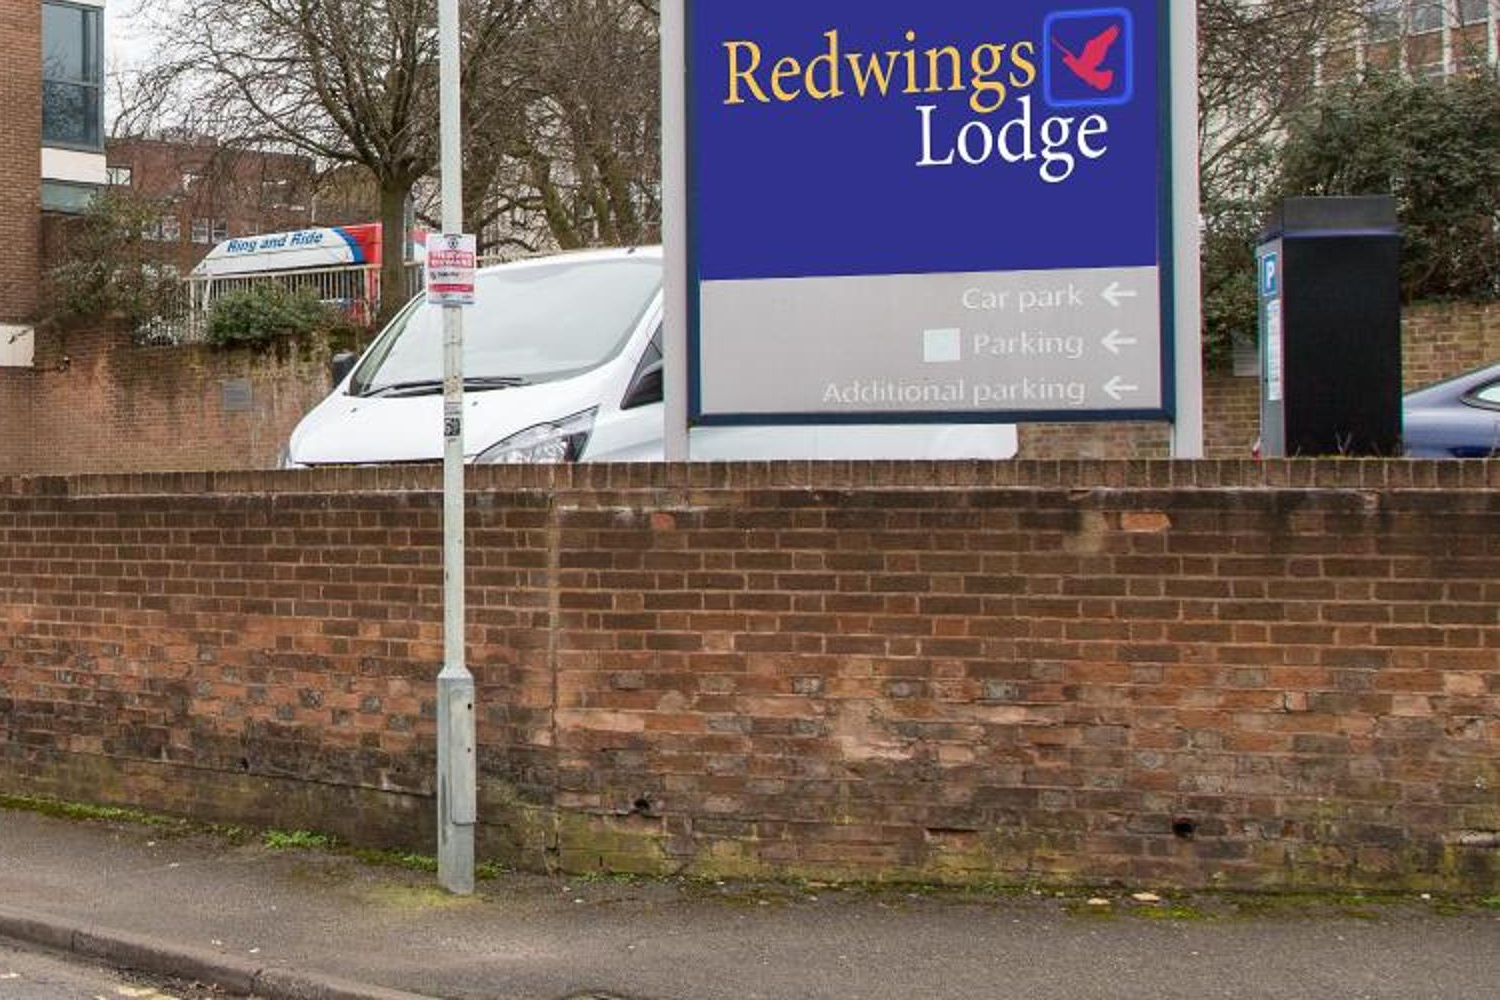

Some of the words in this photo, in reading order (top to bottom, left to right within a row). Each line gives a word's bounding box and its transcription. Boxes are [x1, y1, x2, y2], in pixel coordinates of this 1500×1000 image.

[722, 29, 1037, 113] Redwings
[915, 96, 1109, 183] Lodge
[227, 238, 257, 253] Ring
[260, 233, 287, 249] and
[291, 231, 323, 247] Ride
[1265, 260, 1276, 289] P
[962, 288, 1009, 309] Car
[1019, 283, 1085, 313] park
[973, 331, 1085, 359] Parking
[822, 379, 965, 404] Additional
[973, 377, 1086, 407] parking
